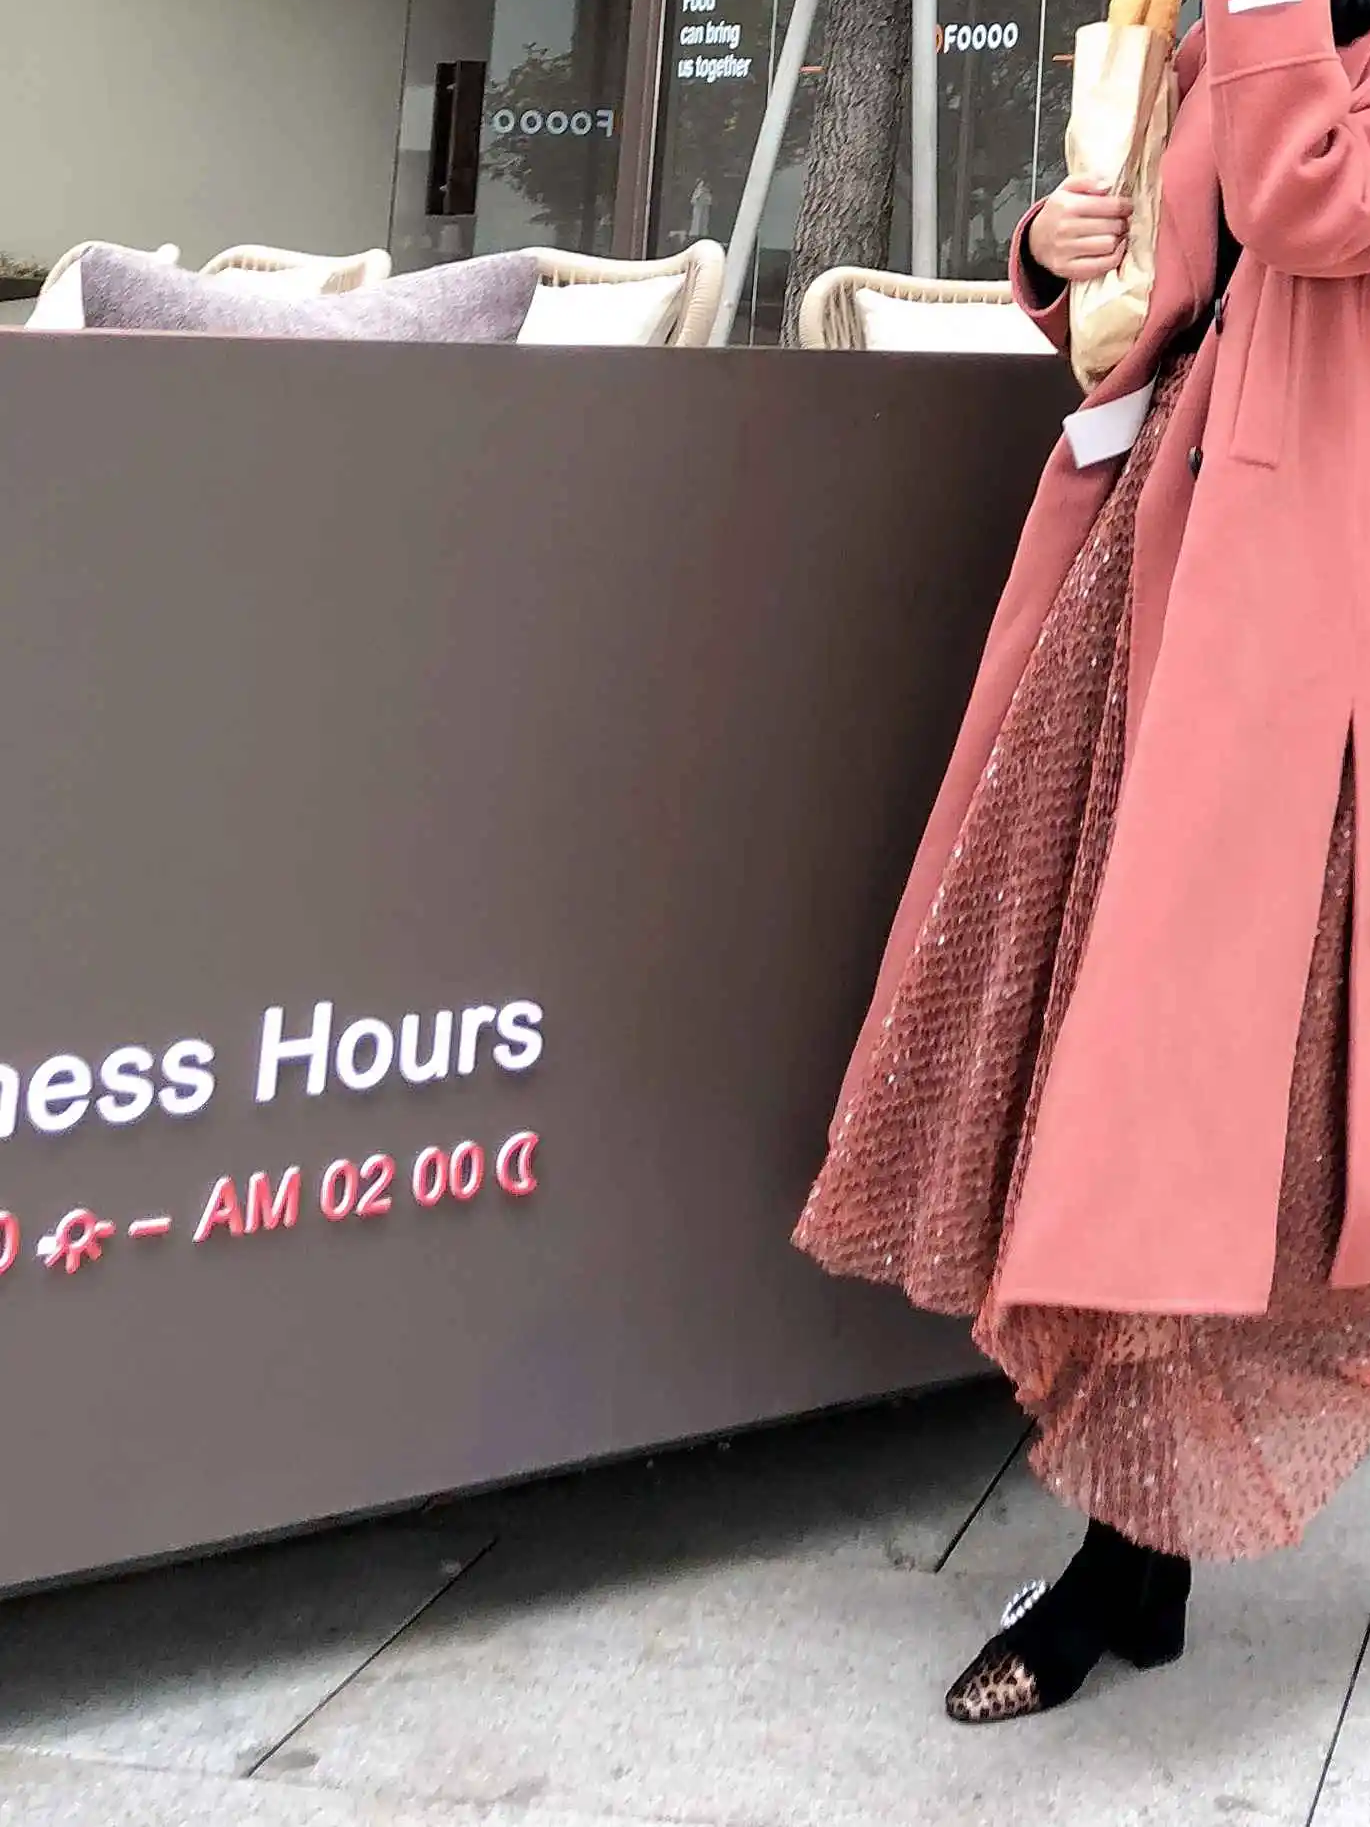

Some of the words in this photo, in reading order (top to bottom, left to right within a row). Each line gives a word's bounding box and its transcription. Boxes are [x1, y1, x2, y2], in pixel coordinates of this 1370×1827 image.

[680, 26, 704, 45] can
[705, 21, 741, 50] bring
[678, 59, 694, 78] us
[695, 54, 752, 84] together
[255, 999, 544, 1103] Hours
[191, 1165, 301, 1243] AM
[319, 1153, 396, 1222] 02
[412, 1140, 485, 1207] 00
